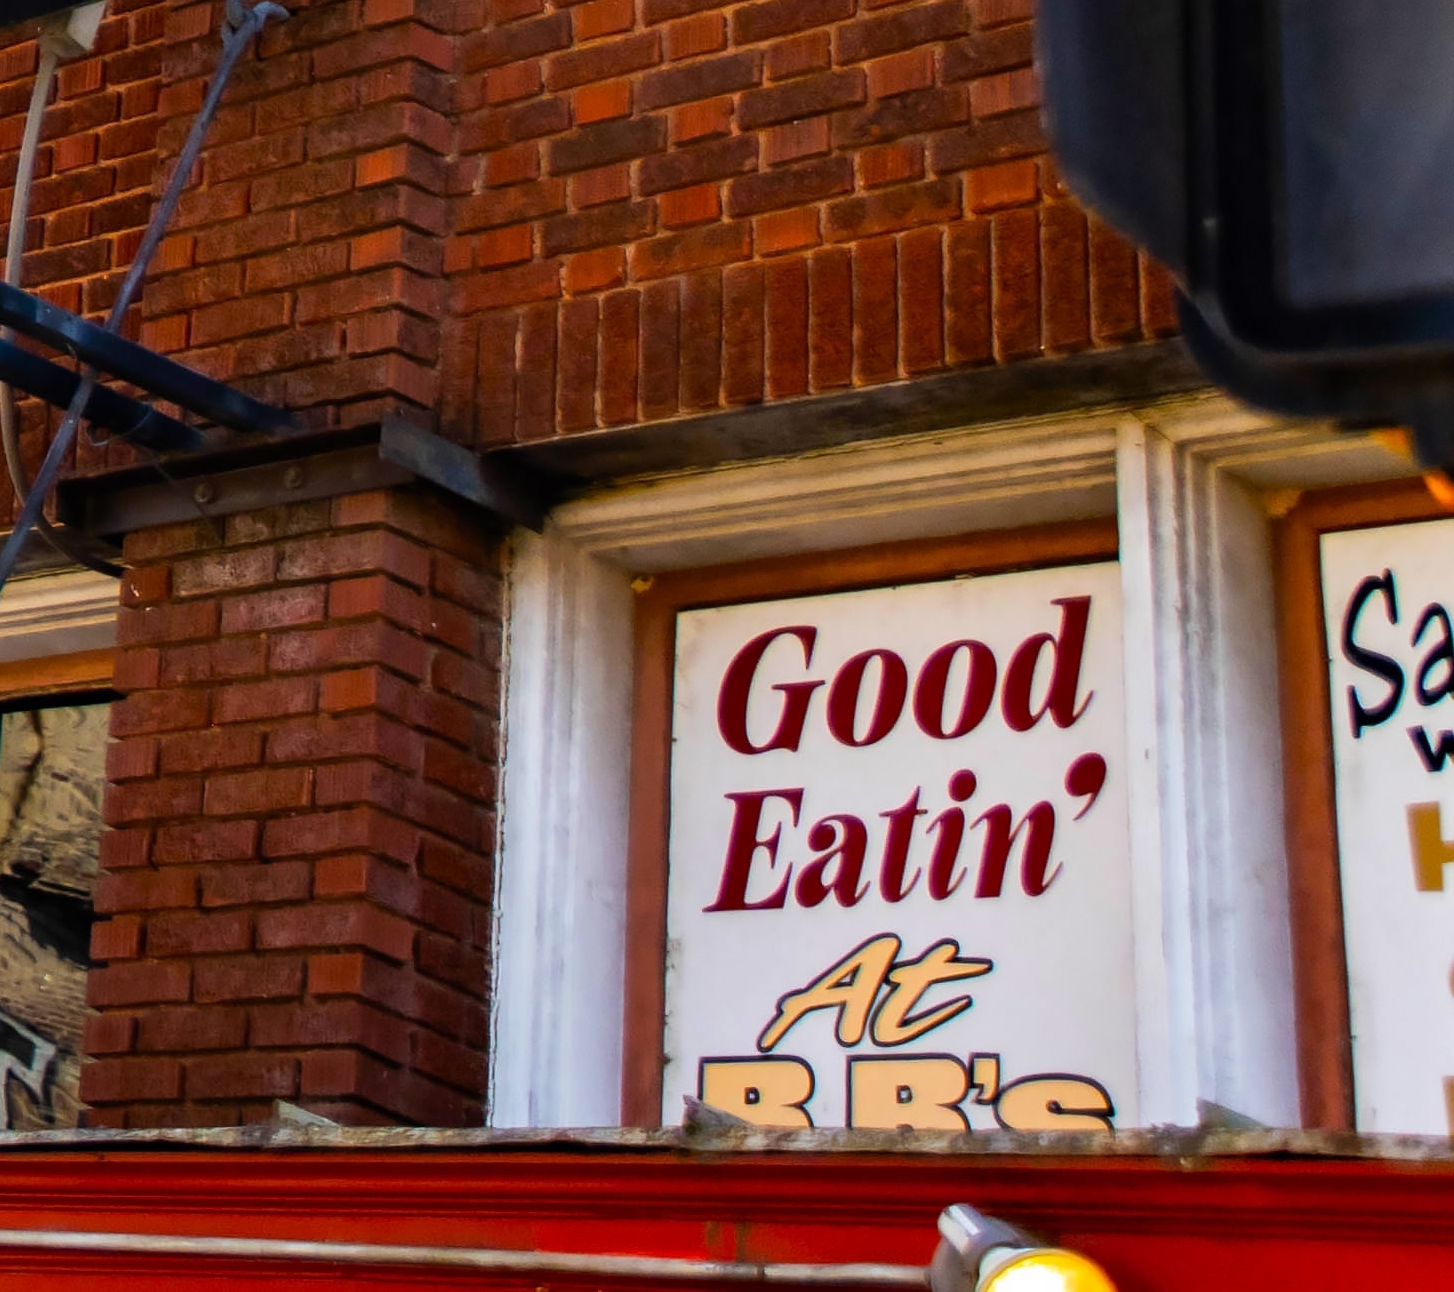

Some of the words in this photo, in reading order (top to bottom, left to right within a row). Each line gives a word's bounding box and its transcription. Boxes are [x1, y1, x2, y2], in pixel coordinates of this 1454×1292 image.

[716, 594, 1095, 757] Good
[702, 752, 1109, 915] Eatin'
[757, 931, 994, 1054] At
